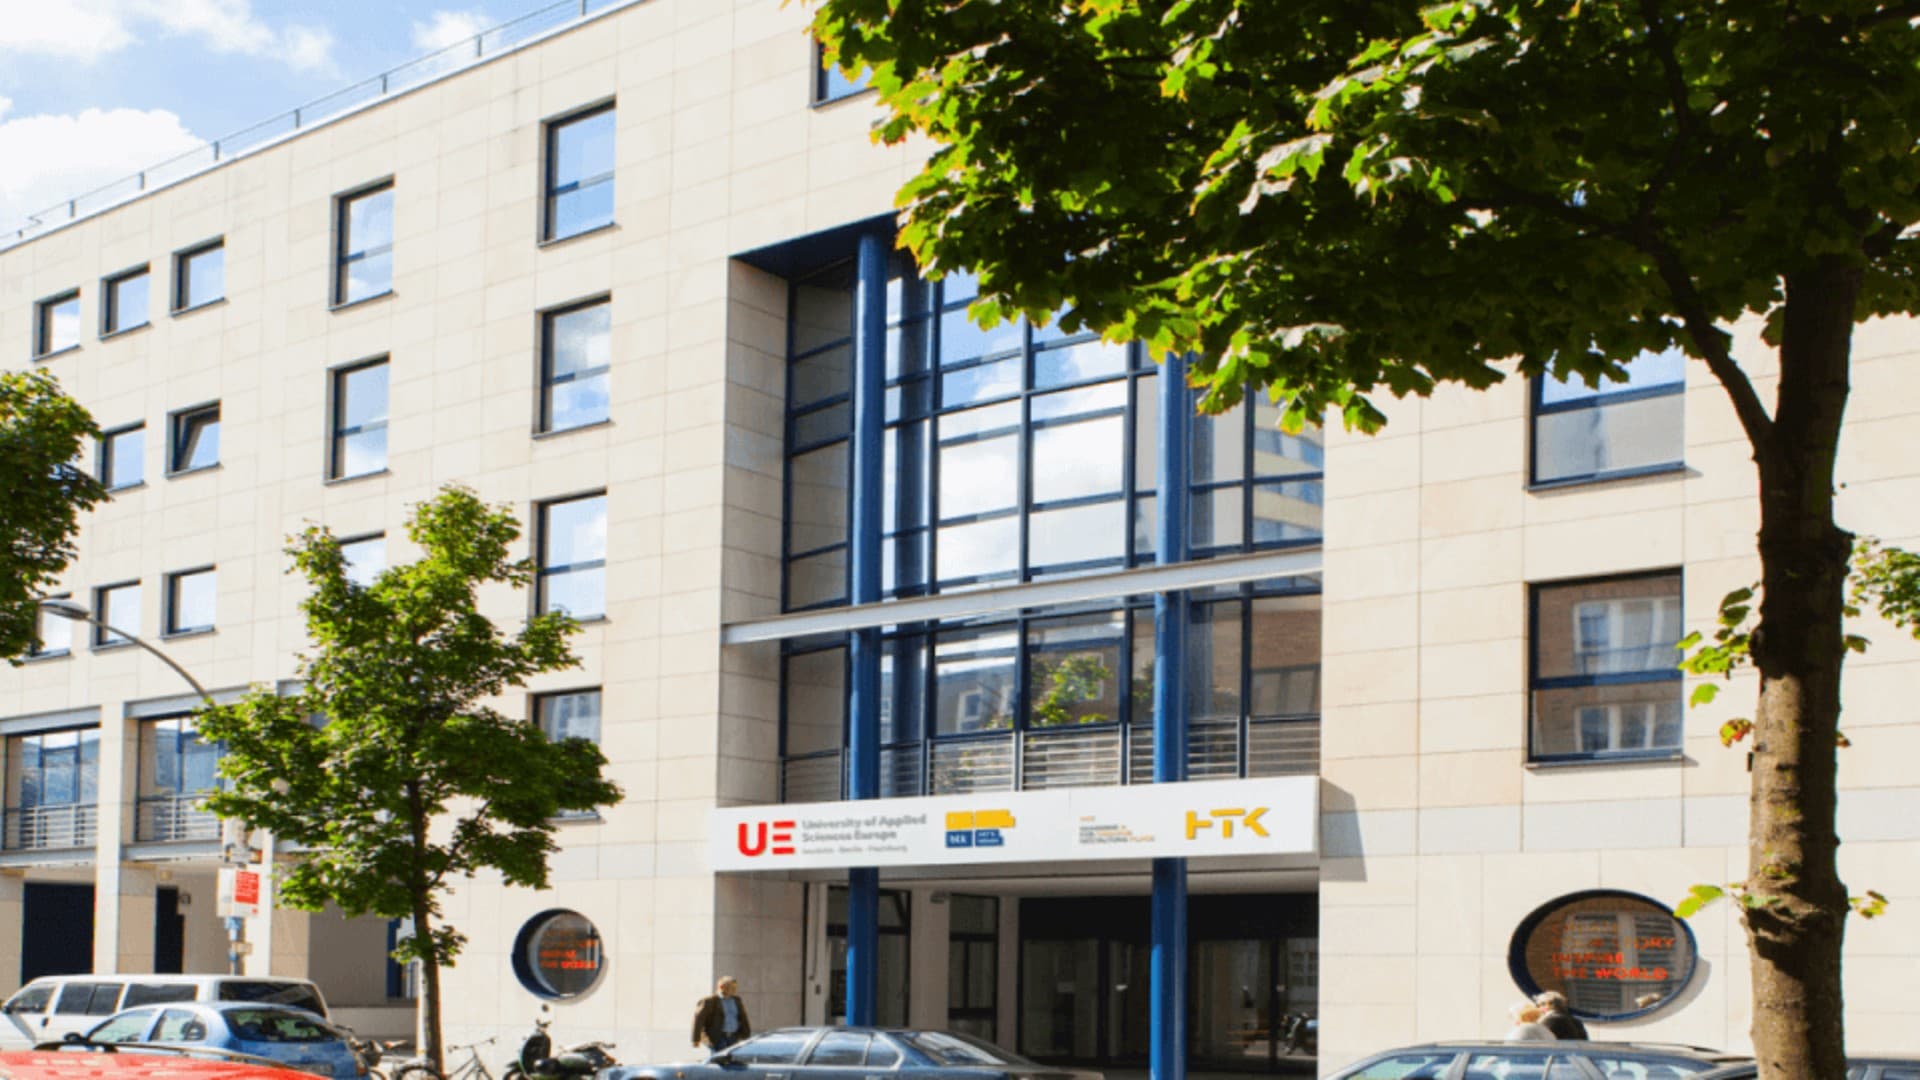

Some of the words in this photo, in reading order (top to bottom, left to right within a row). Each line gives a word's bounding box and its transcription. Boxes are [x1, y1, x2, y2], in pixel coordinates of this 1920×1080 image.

[801, 818, 862, 830] University
[864, 816, 877, 826] of
[879, 813, 926, 828] Applied
[1184, 807, 1270, 840] HTK
[737, 820, 797, 857] UE
[801, 831, 852, 842] Sciences
[854, 829, 897, 842] Europe
[1594, 966, 1669, 980] WORLD
